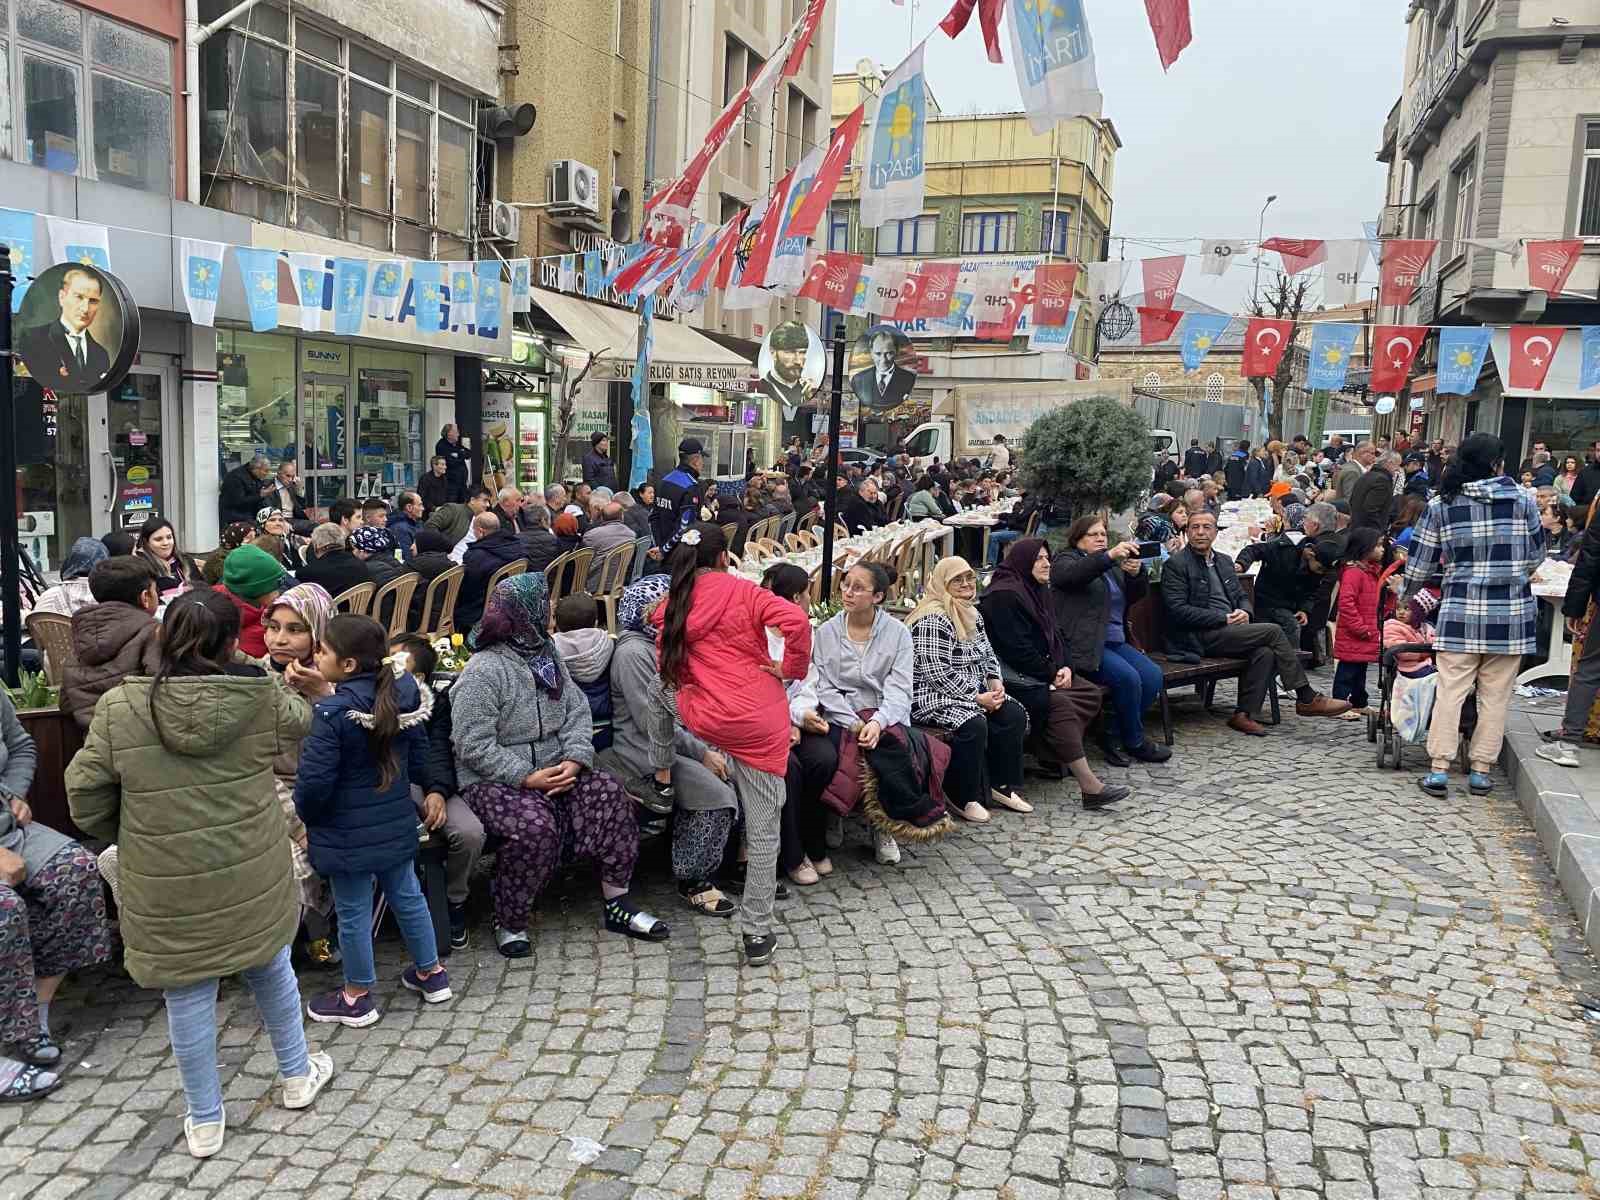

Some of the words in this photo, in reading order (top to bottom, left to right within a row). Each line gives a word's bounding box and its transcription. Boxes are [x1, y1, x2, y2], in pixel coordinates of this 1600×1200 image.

[307, 350, 342, 361] SUNNY
[679, 367, 702, 381] SATIŞ
[707, 367, 737, 379] REYONU
